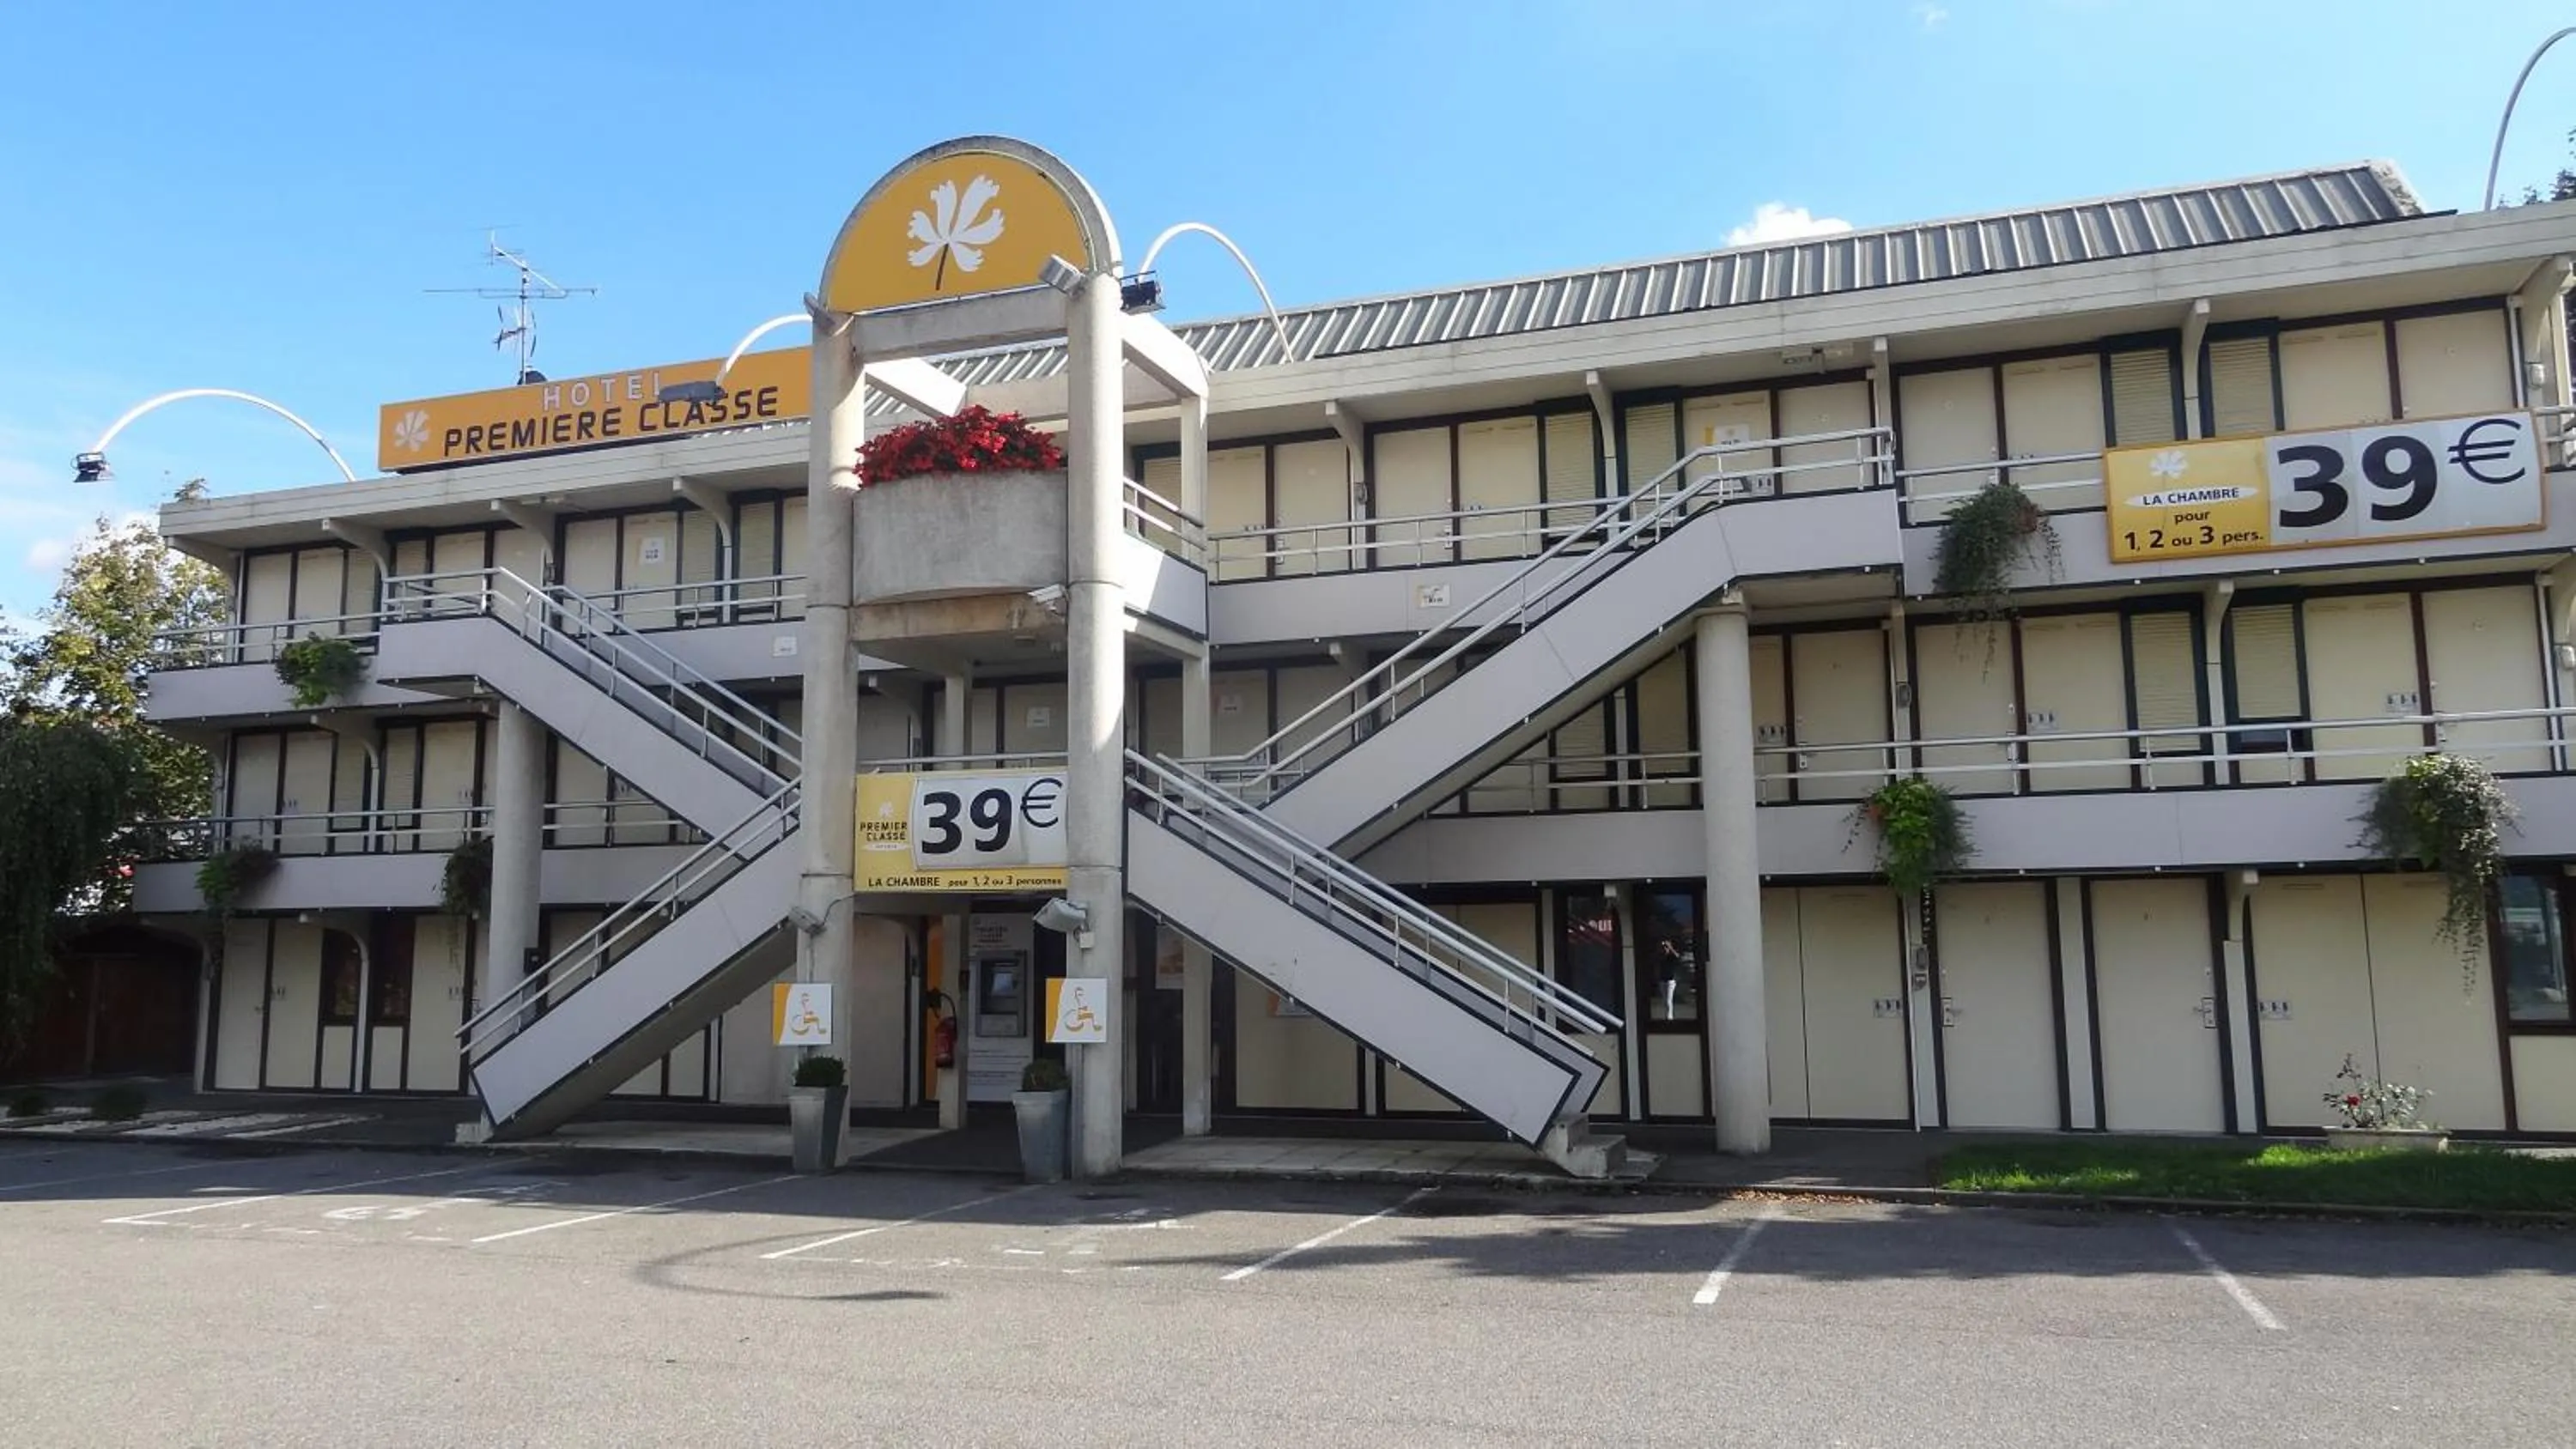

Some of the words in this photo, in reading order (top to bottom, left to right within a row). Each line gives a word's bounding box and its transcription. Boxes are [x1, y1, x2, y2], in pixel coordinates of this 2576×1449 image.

[444, 406, 622, 457] PREMIERE
[639, 385, 778, 431] CLASSE
[2143, 495, 2162, 506] LA
[2168, 487, 2239, 504] CHAMBRE
[2174, 511, 2211, 524] pour
[2149, 530, 2165, 549] 2
[2172, 536, 2192, 547] ou
[2199, 525, 2215, 544] 3
[2222, 530, 2264, 546] pers.
[866, 832, 907, 842] CLASSE
[868, 878, 883, 887] LA
[886, 876, 940, 887] CHAMBRE
[983, 876, 990, 885] 2
[1006, 875, 1013, 885] 3
